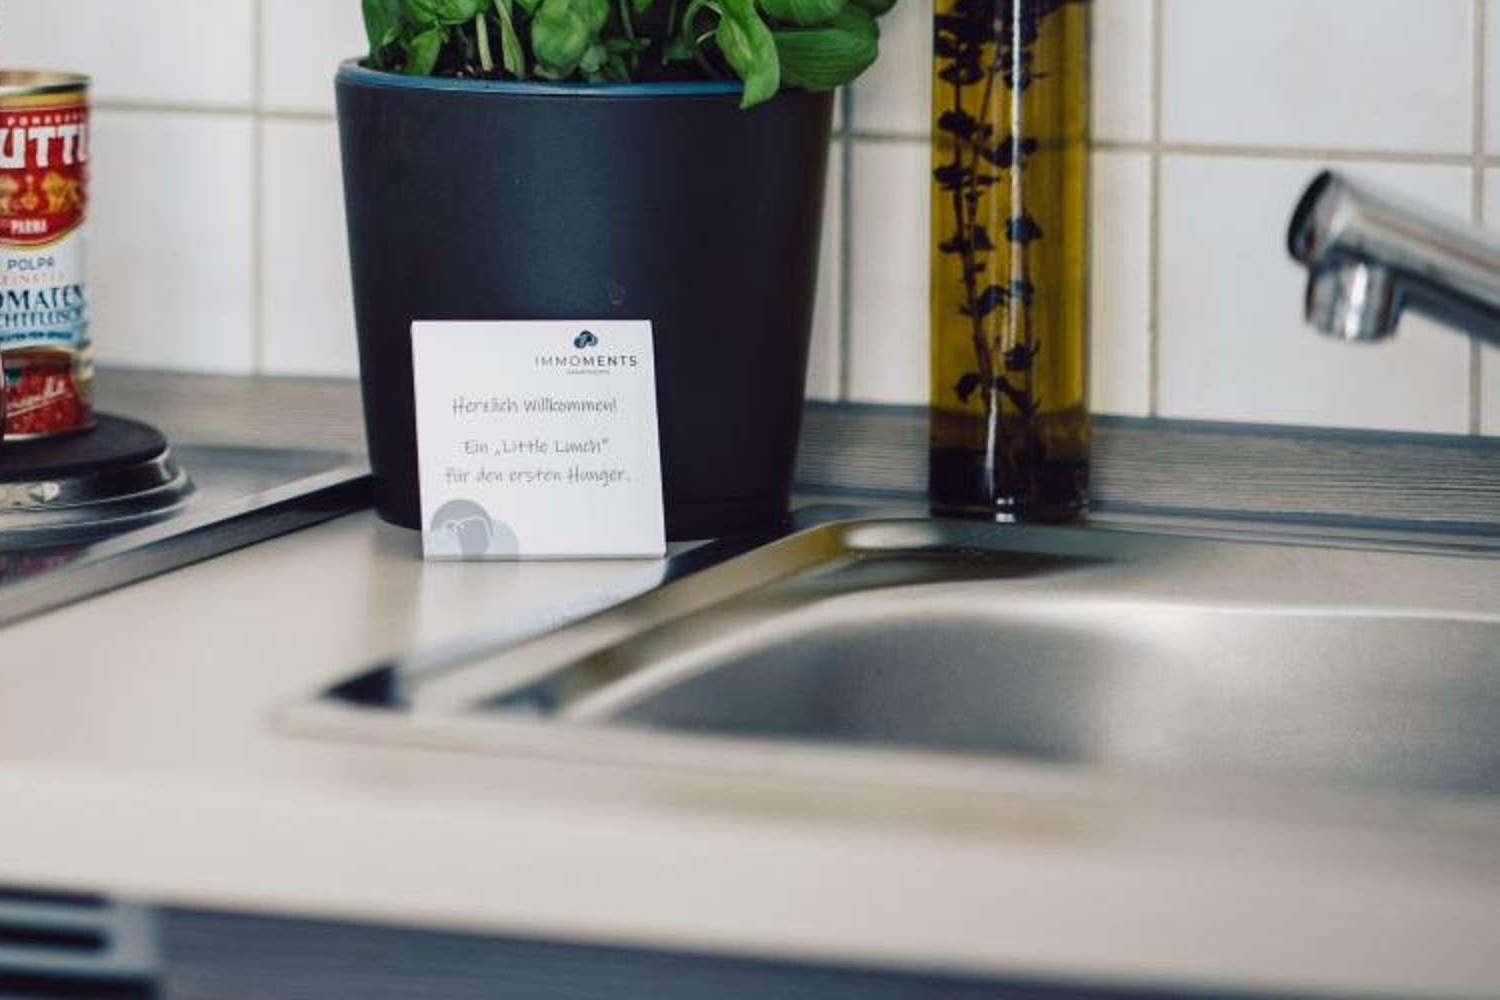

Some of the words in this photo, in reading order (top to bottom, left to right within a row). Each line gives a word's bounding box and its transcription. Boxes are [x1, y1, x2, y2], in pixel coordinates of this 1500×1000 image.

[534, 355, 638, 367] IMMOMENTS
[452, 396, 518, 415] Herzlich
[460, 439, 489, 455] Ein
[476, 466, 503, 483] den
[509, 468, 561, 483] ersten
[568, 465, 632, 487] Hunger.
